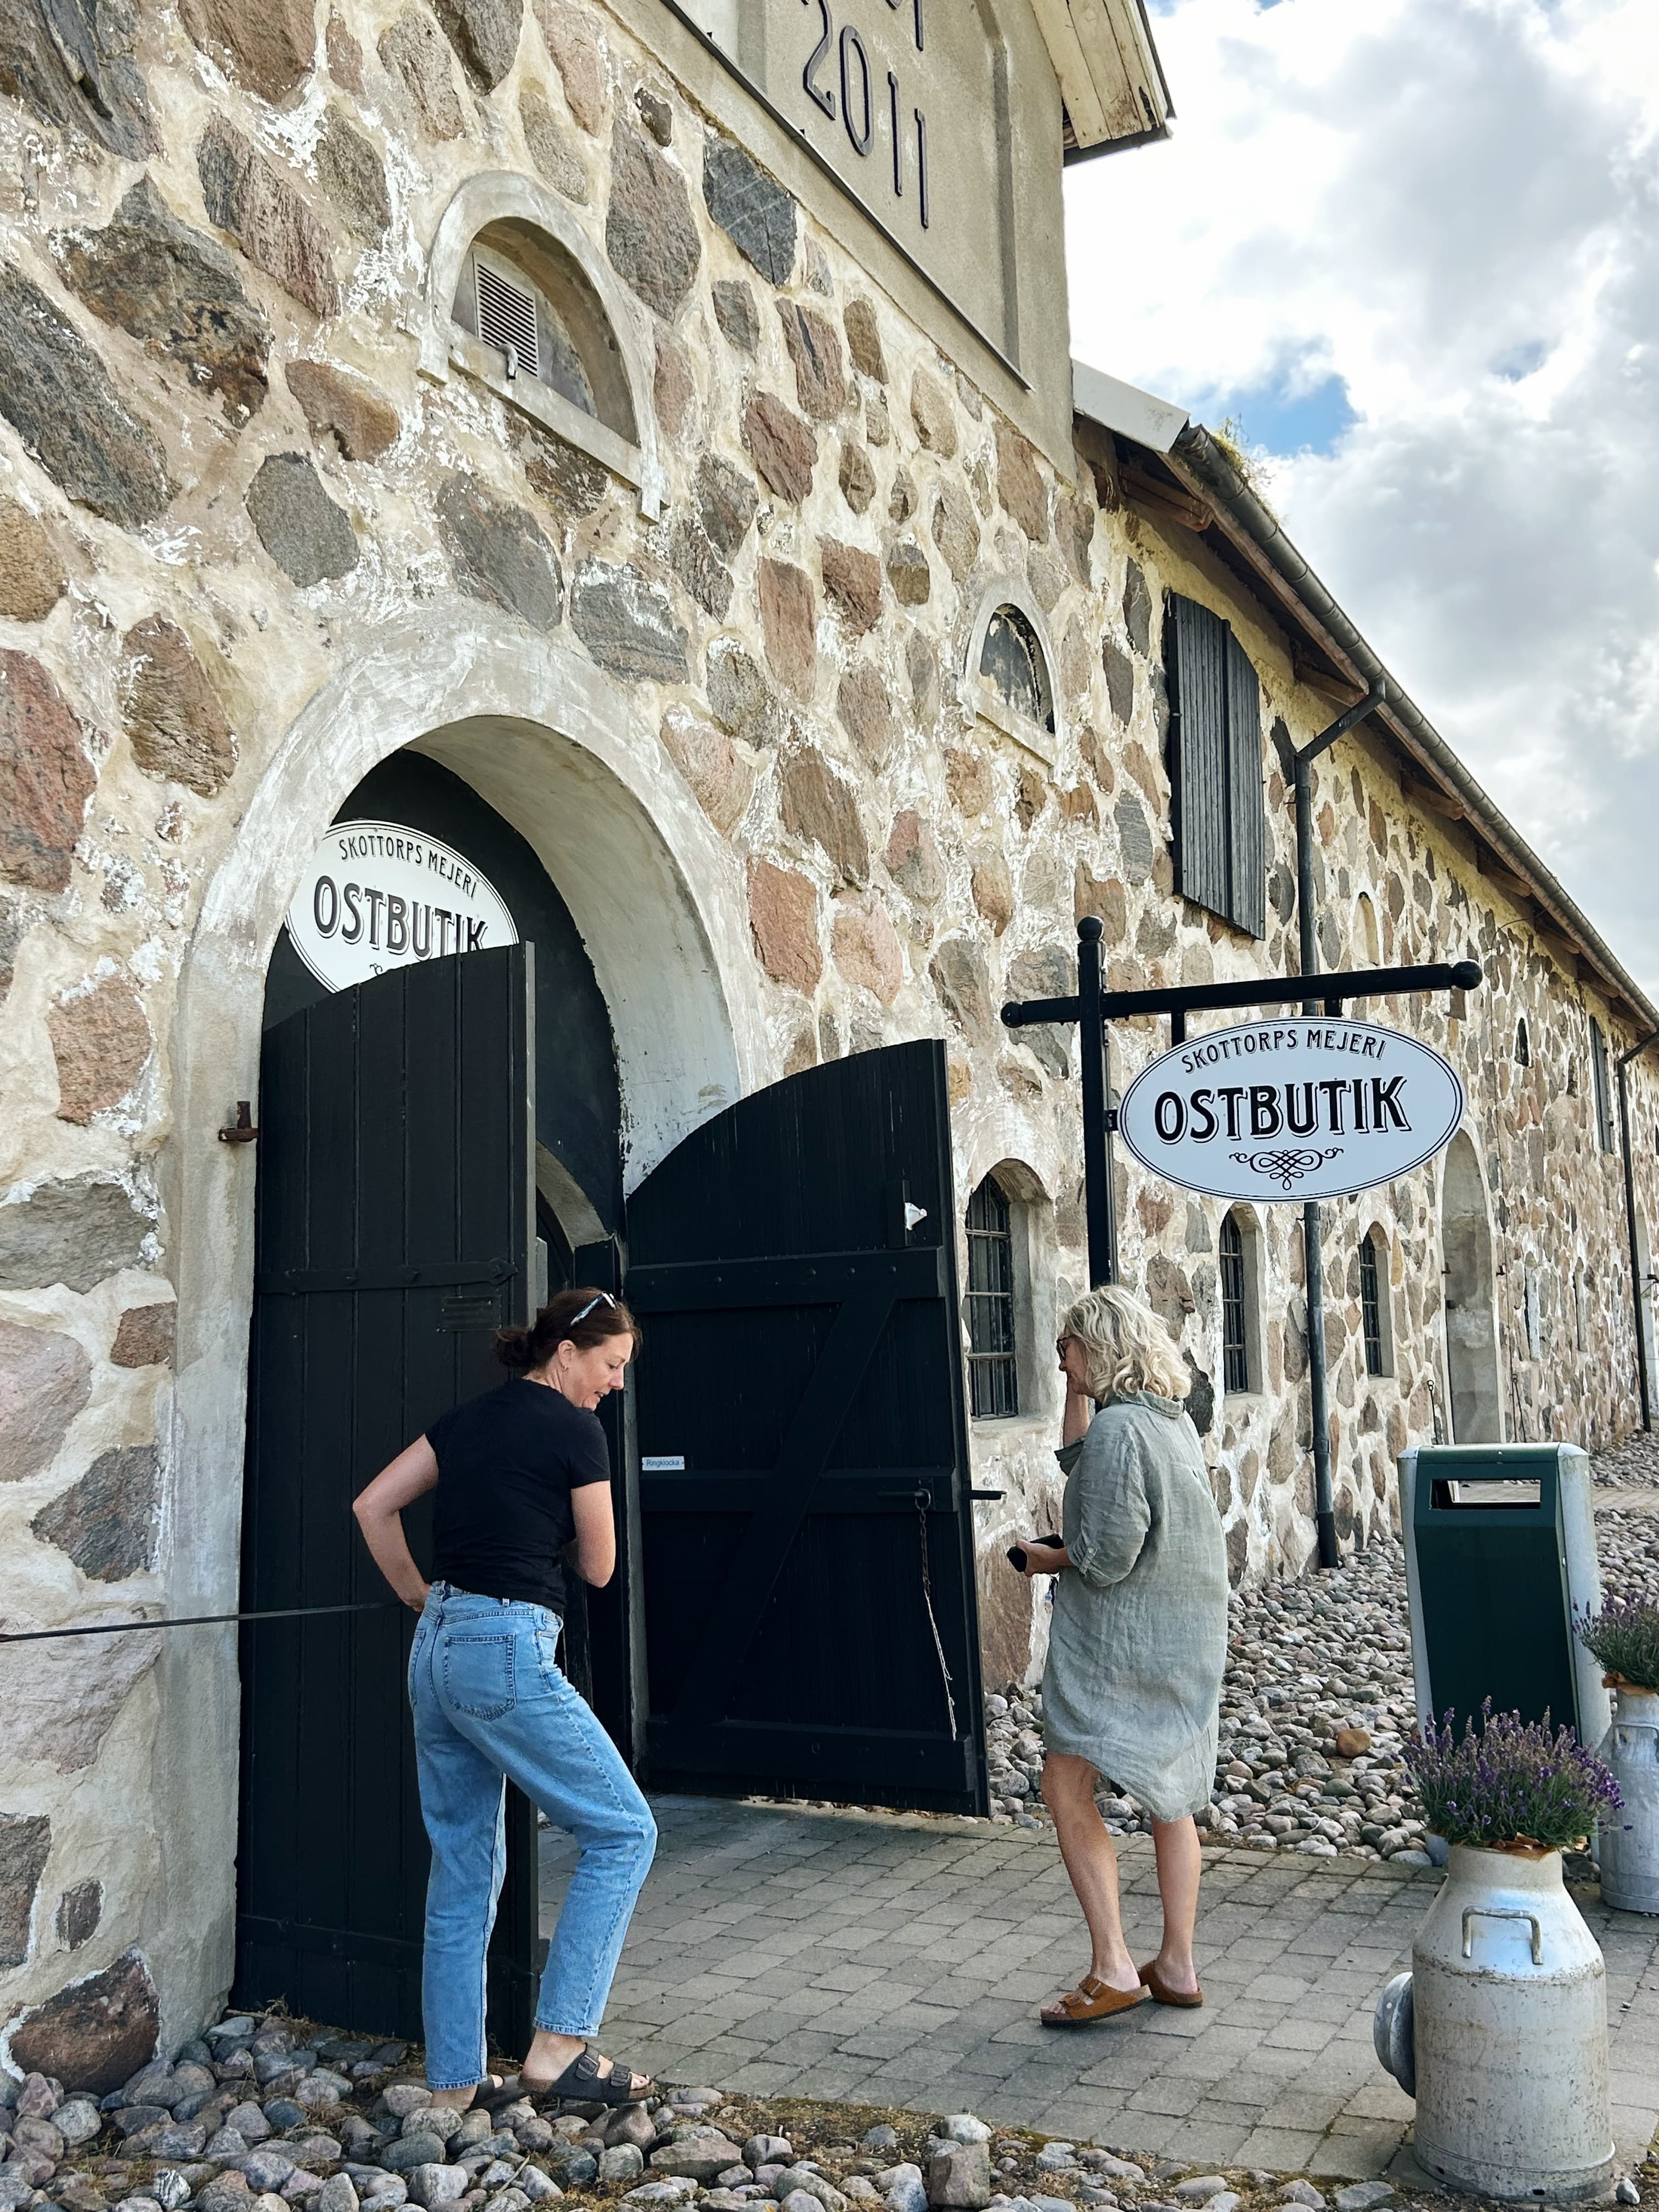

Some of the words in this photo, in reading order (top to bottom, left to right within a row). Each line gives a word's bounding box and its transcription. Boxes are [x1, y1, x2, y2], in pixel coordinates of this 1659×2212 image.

[801, 0, 929, 229] 2011
[338, 835, 423, 865] SKOTTORPS
[428, 849, 478, 901] MEJERI
[313, 875, 489, 961] OSTBUTIK
[1181, 1029, 1299, 1075] SKOTTORPS
[1306, 1029, 1387, 1060] MEJERI
[1154, 1076, 1412, 1146] OSTBUTIK
